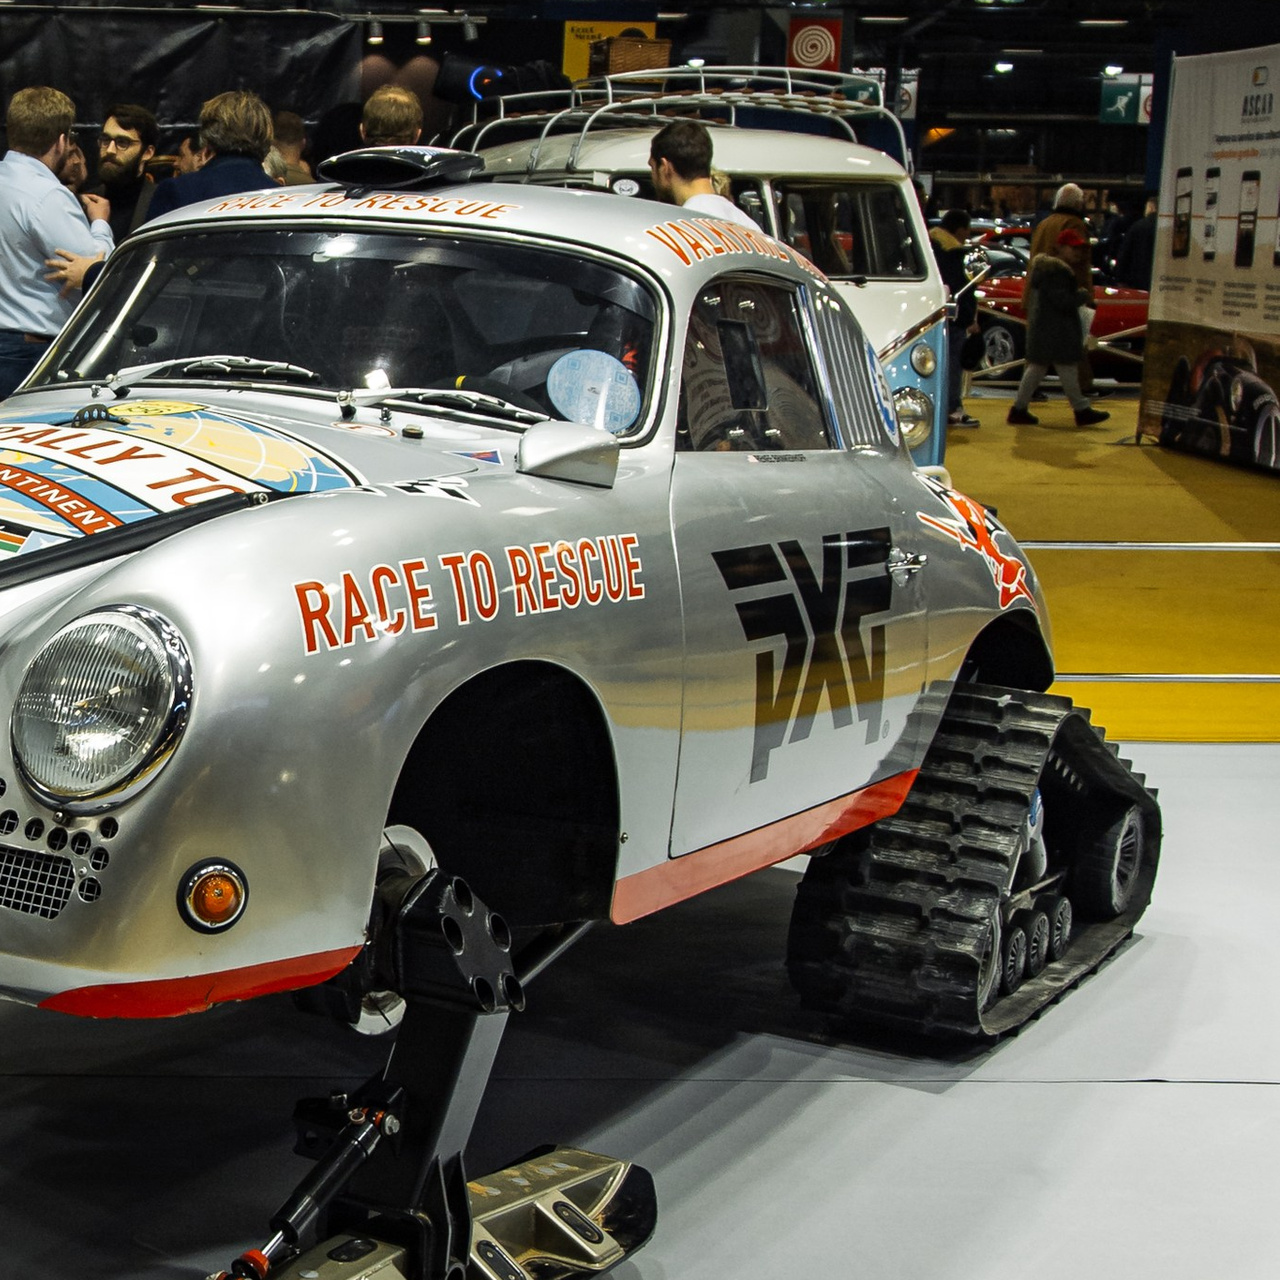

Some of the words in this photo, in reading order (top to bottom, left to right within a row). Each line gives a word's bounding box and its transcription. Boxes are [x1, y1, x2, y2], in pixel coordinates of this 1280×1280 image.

[206, 194, 297, 214] RACE
[359, 193, 523, 220] RESCUE
[292, 557, 438, 656] RACE
[438, 549, 499, 626] TO
[503, 532, 646, 618] RESCUE
